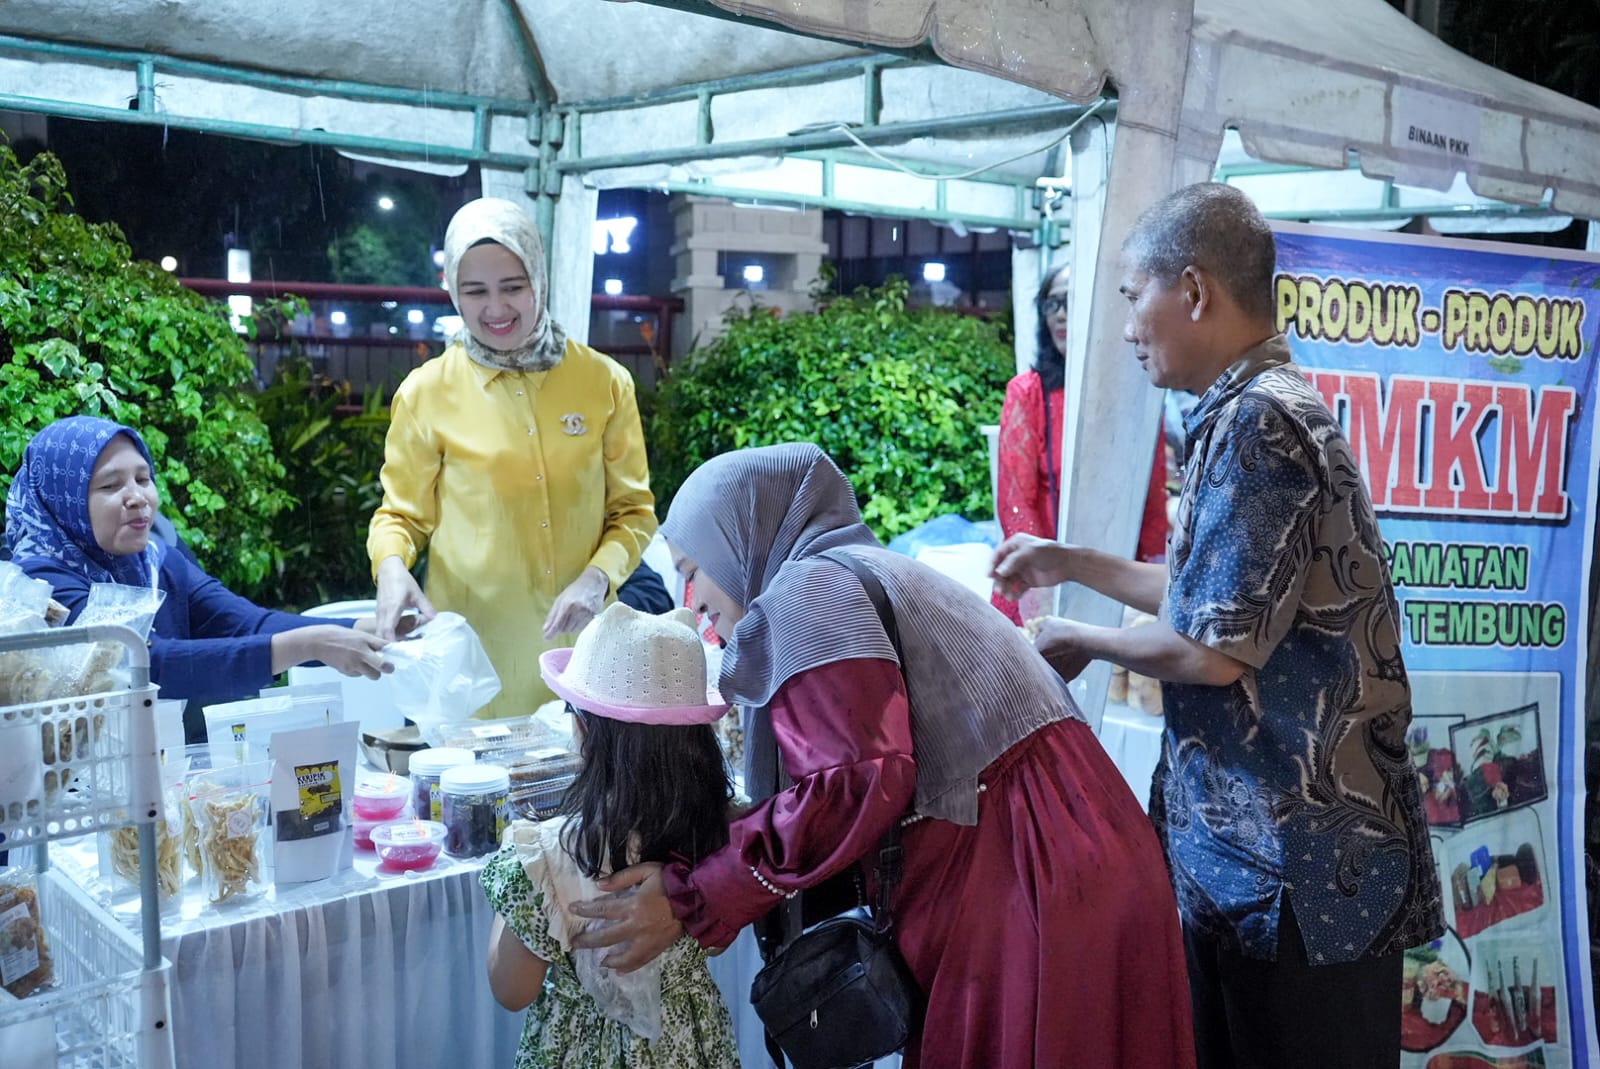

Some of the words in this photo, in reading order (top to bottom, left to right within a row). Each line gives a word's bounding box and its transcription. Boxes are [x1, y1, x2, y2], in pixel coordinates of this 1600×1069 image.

[1408, 125, 1447, 150] BINAAN
[1449, 137, 1470, 157] PKK
[1384, 542, 1528, 592] AMATAN
[1405, 600, 1566, 647] TEMBUNG
